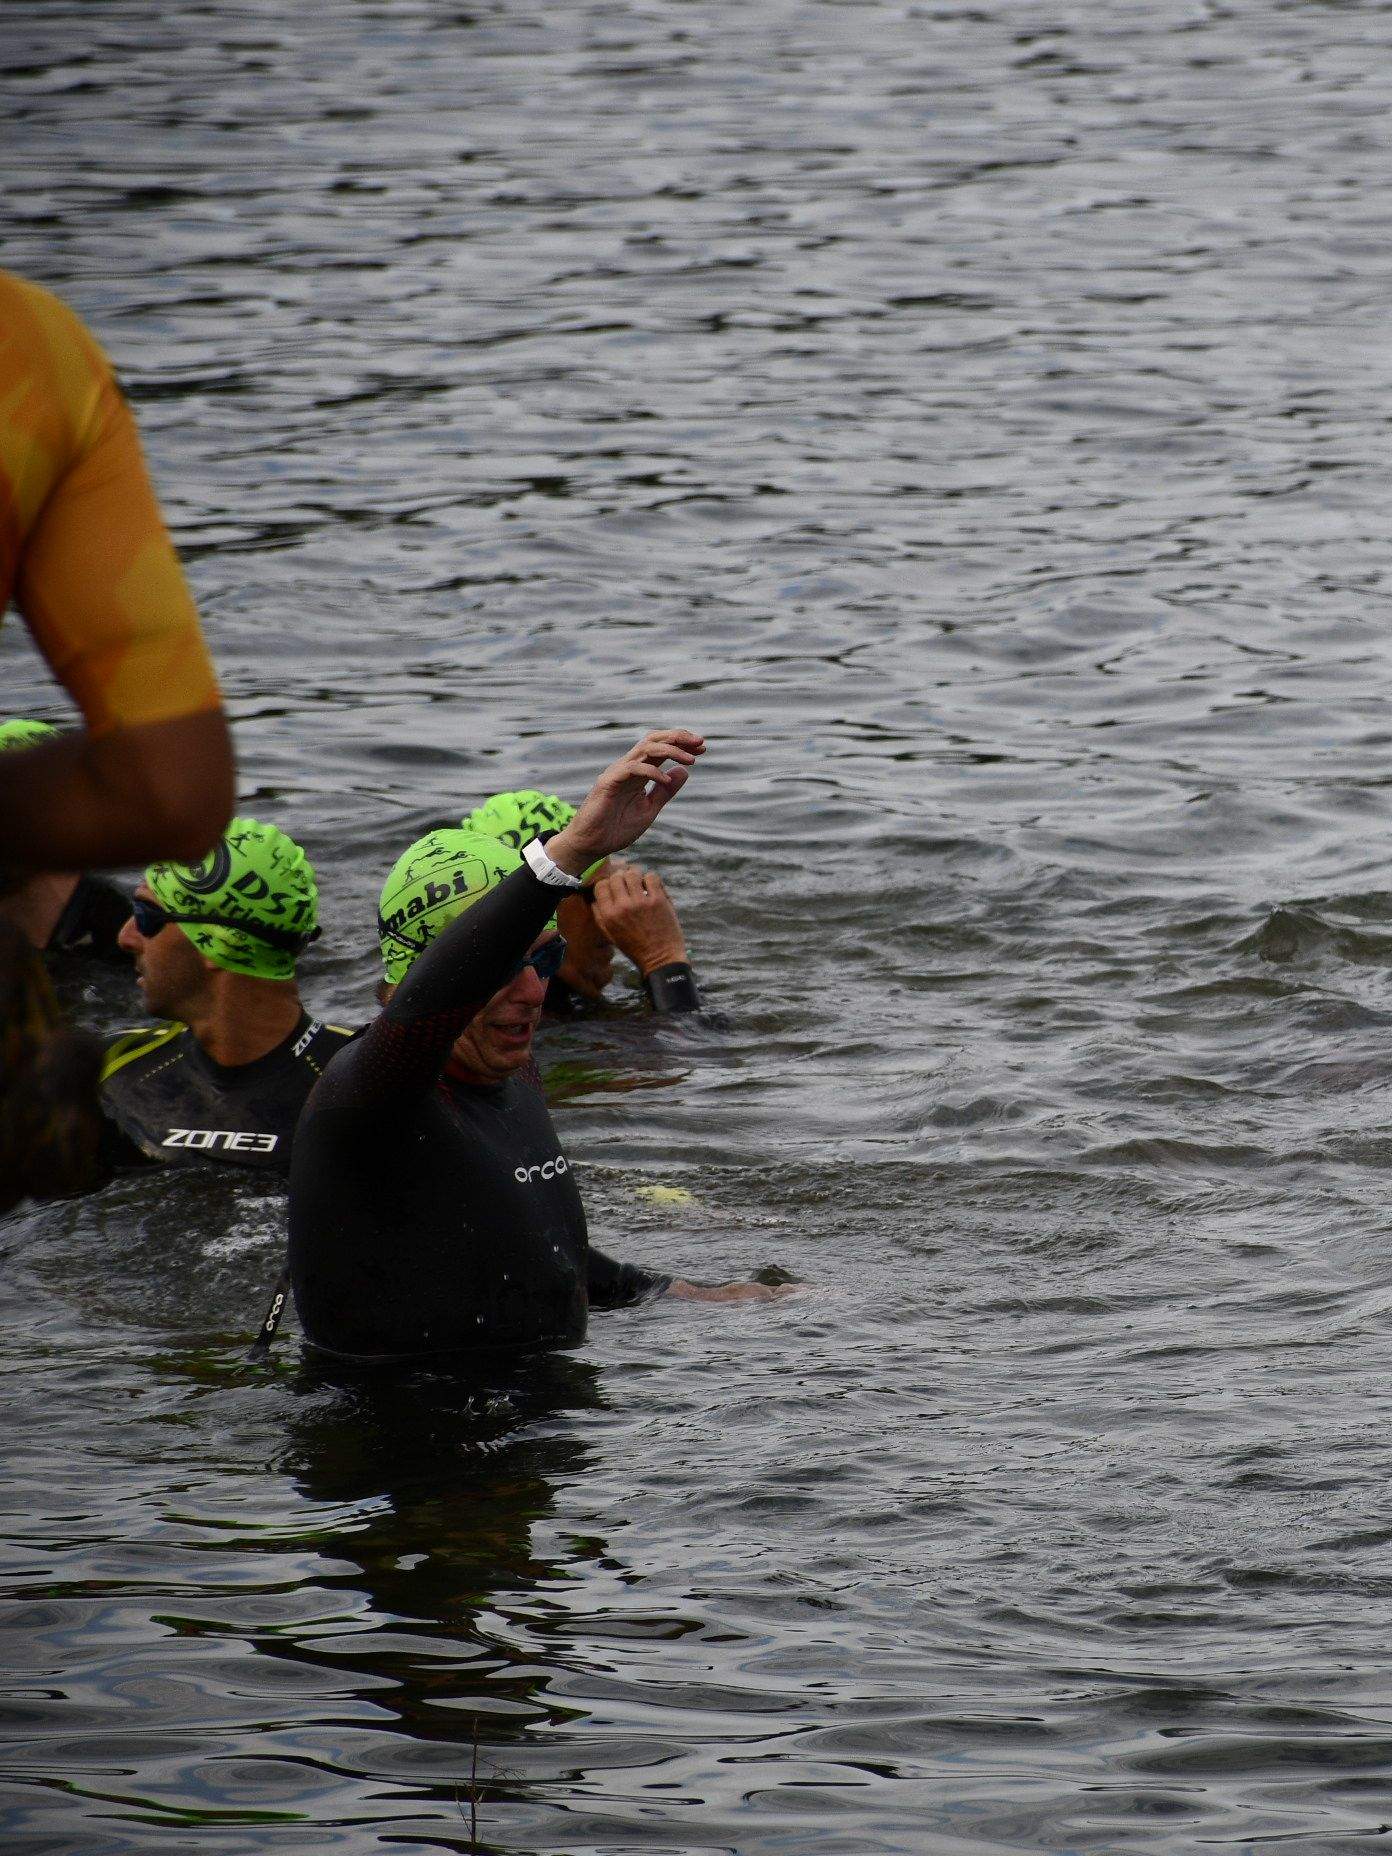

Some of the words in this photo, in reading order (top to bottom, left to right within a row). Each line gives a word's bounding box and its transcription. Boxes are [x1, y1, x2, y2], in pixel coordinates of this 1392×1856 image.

[162, 1128, 280, 1153] ZONE3
[514, 1155, 568, 1183] orca
[266, 1293, 284, 1331] orca
